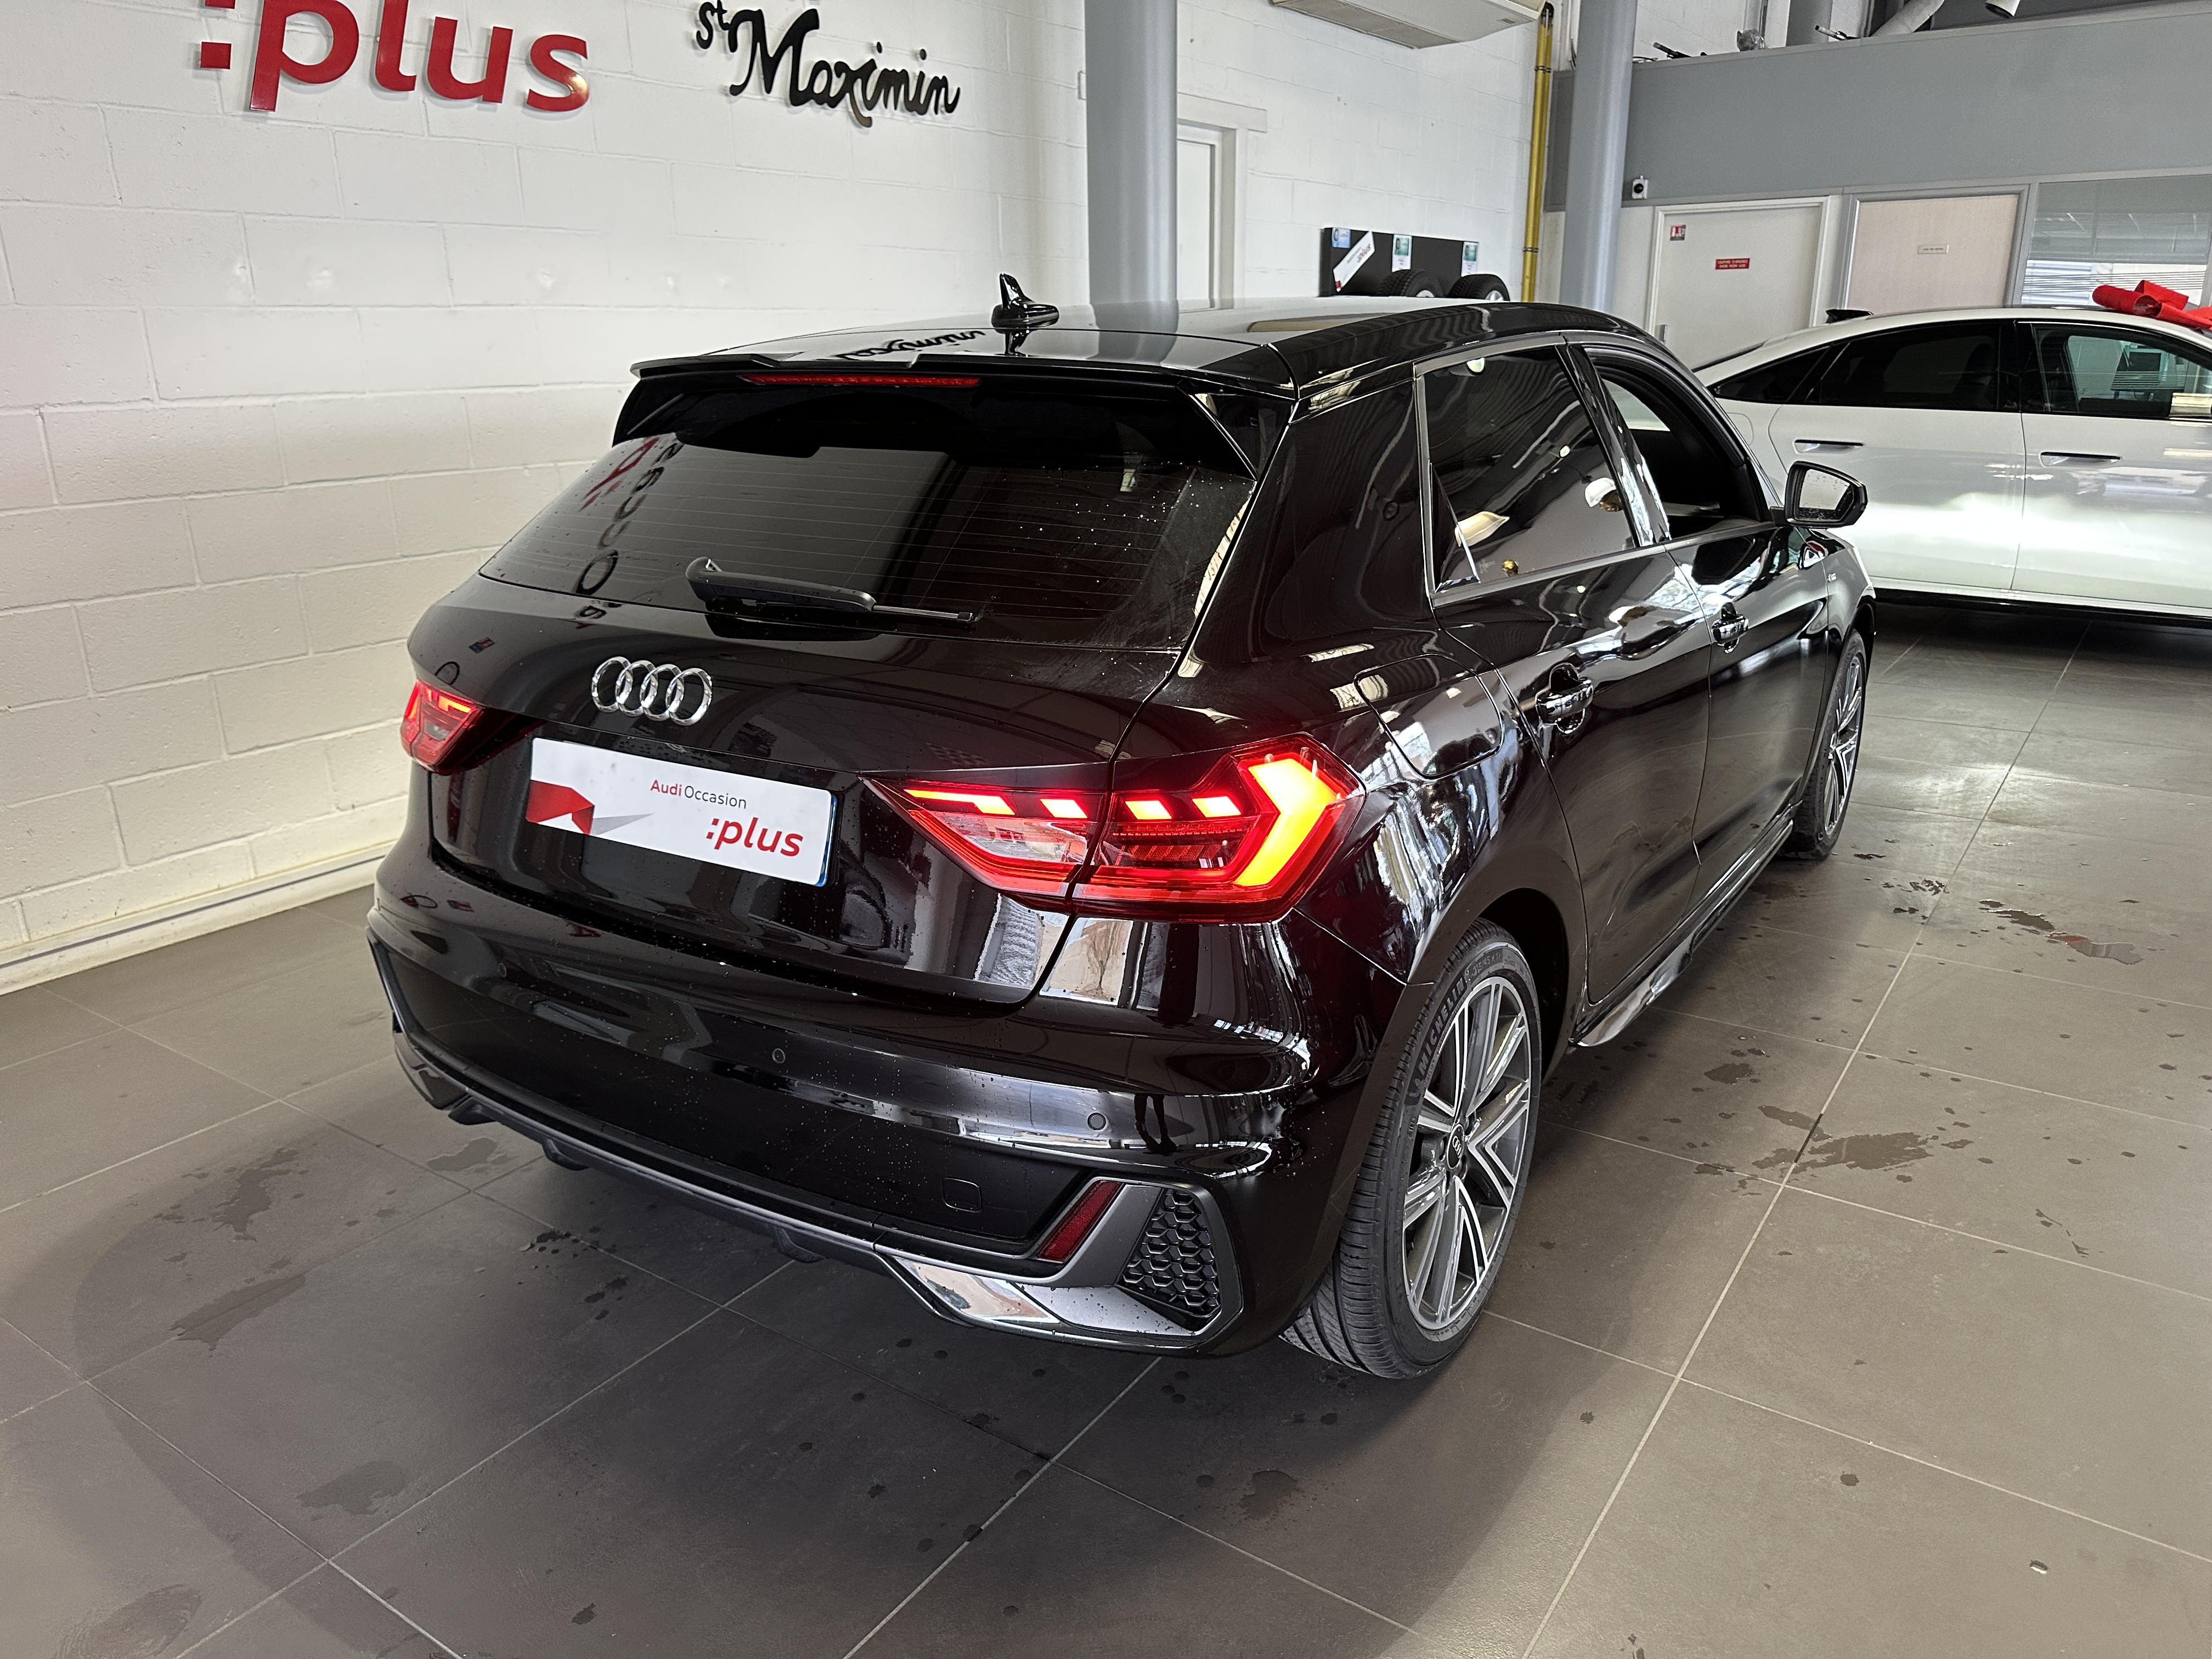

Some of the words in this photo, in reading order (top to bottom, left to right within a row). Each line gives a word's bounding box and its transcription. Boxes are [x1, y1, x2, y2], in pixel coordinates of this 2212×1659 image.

[729, 9, 960, 128] Maximin
[650, 780, 682, 797] Audi
[684, 786, 747, 809] Occasion
[706, 817, 804, 857] :plus
[1418, 977, 1465, 1076] MICHELIN
